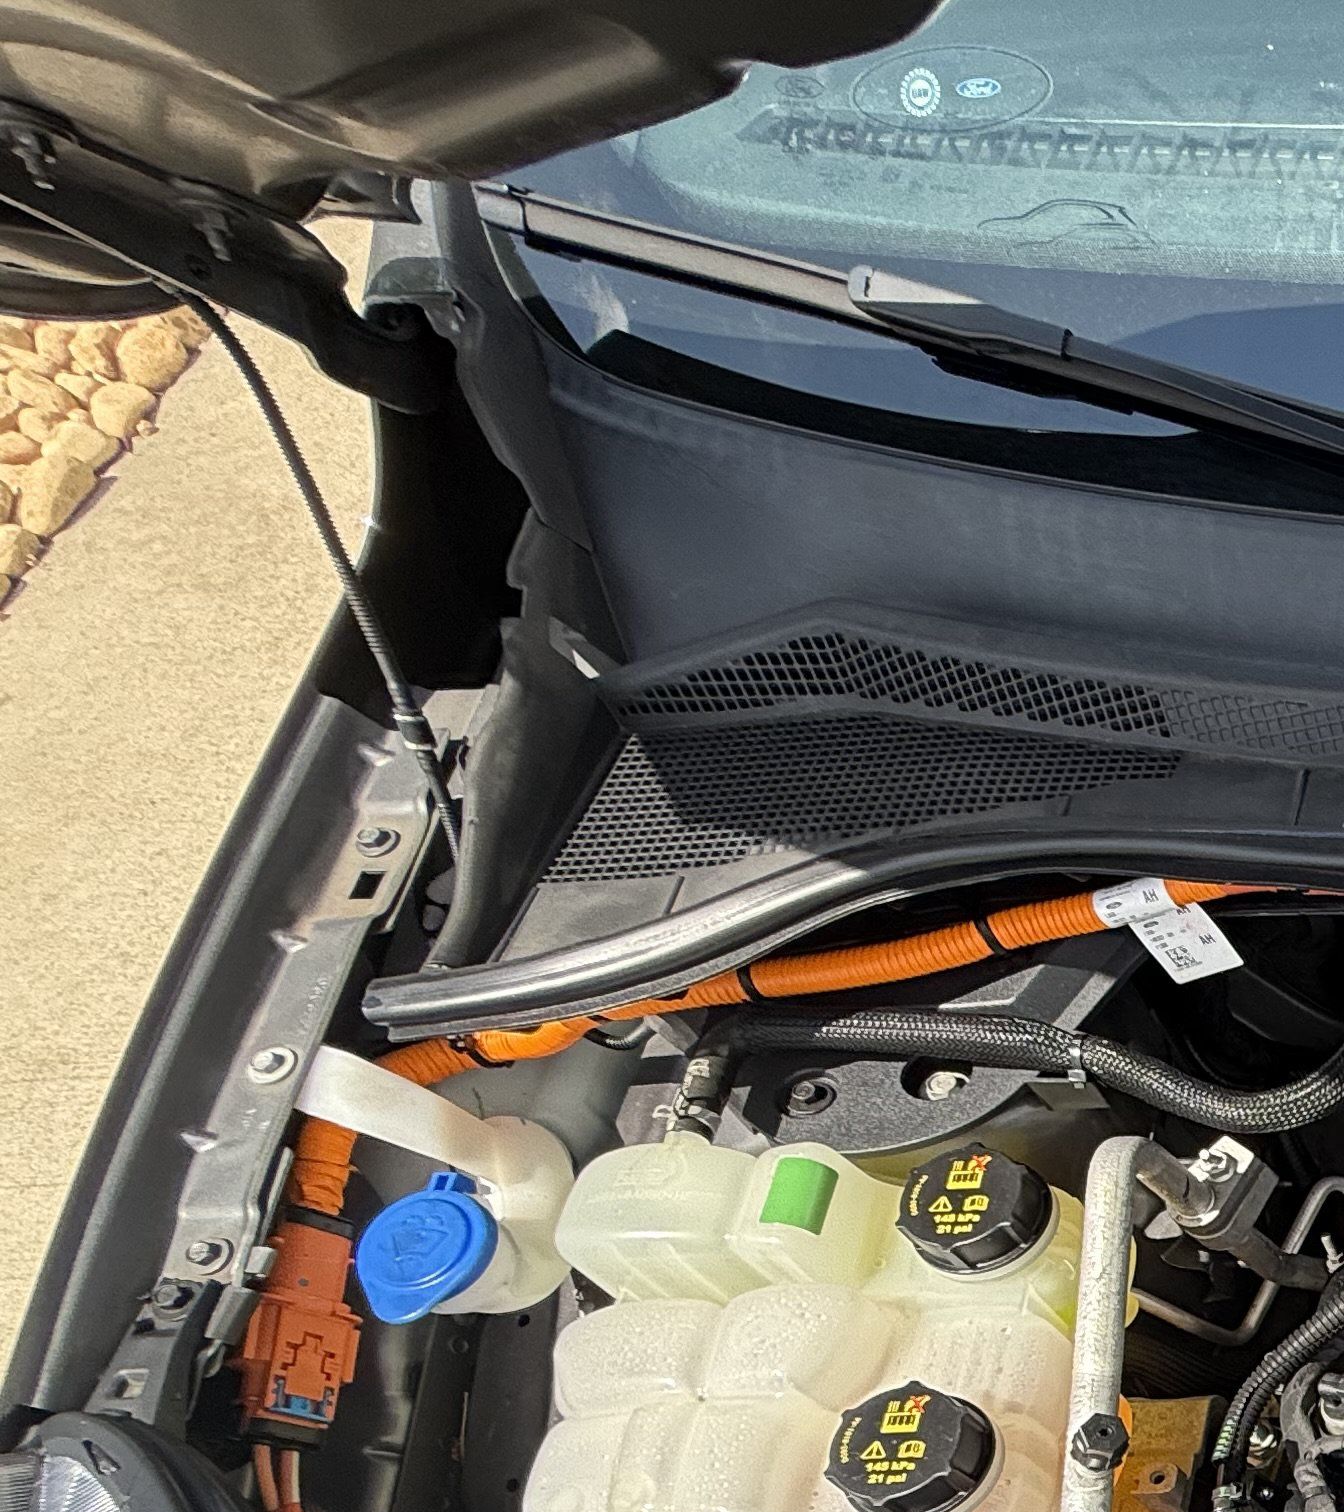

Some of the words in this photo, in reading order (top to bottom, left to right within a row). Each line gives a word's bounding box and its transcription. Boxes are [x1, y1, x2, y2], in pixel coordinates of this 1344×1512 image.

[1142, 888, 1159, 904] AH
[1198, 933, 1217, 946] AH
[935, 1225, 951, 1234] 21
[952, 1223, 973, 1235] psi
[890, 1461, 916, 1471] kPa
[867, 1473, 884, 1484] 21
[886, 1472, 907, 1485] psi
